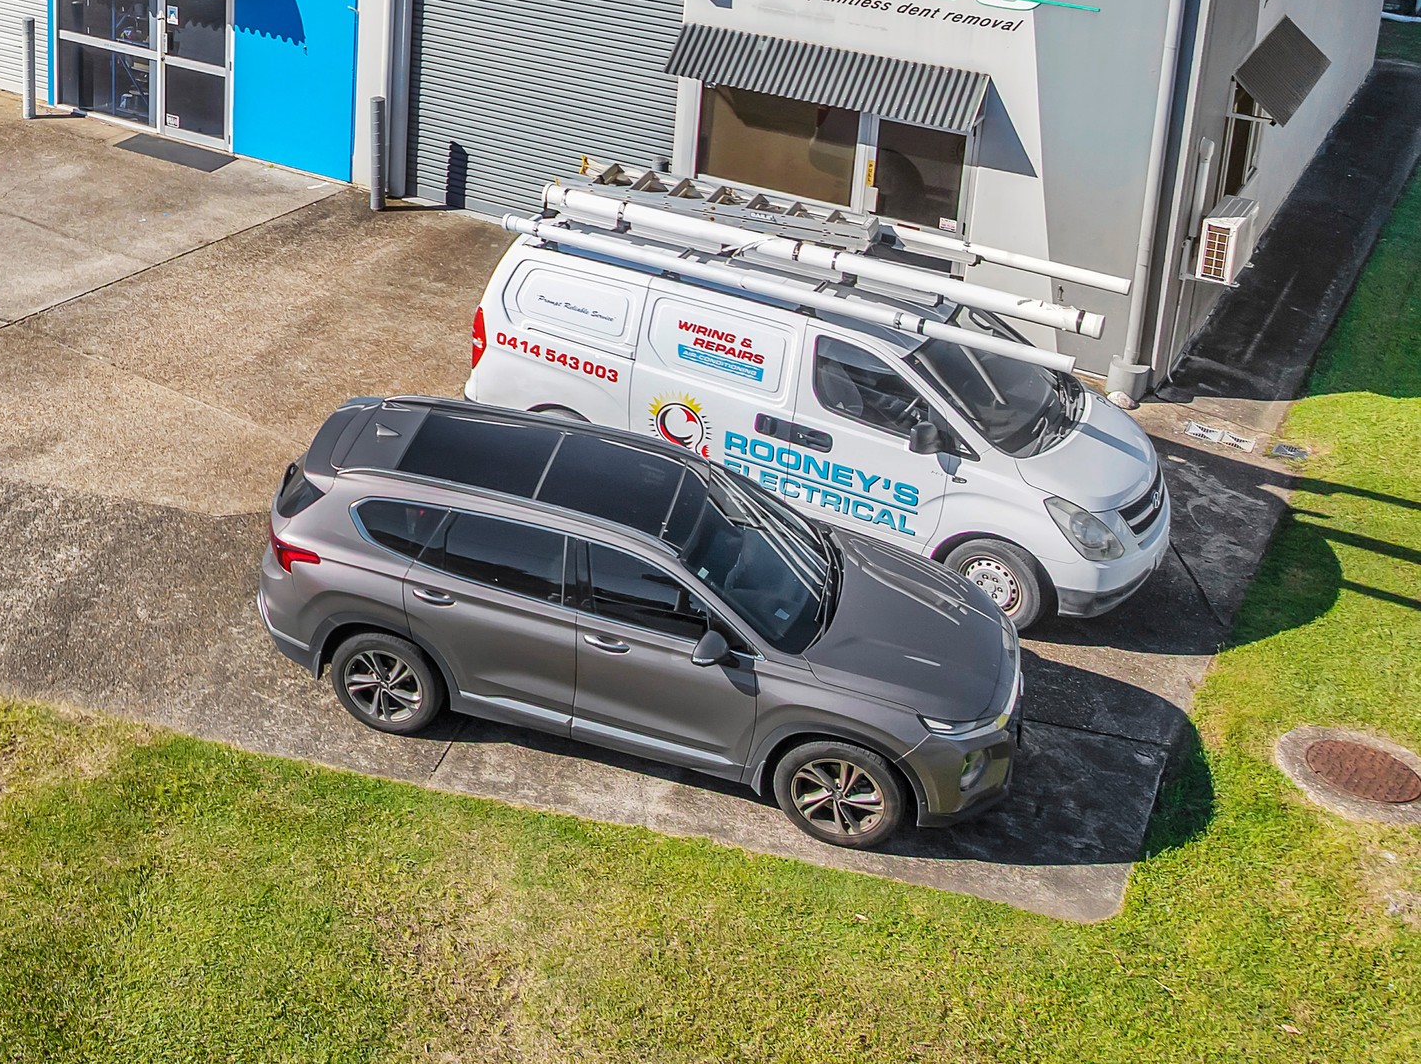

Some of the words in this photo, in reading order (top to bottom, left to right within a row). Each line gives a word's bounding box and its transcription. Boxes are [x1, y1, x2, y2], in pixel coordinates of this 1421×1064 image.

[896, 1, 941, 20] dent
[943, 10, 1024, 33] removal
[564, 302, 589, 315] Reliable
[678, 319, 736, 344] WIRING
[740, 337, 753, 349] &
[496, 332, 541, 358] 0414
[545, 349, 580, 371] 543
[582, 361, 619, 384] 003
[681, 349, 758, 378] AIR-CONDITIONING
[693, 337, 765, 365] REPAIRS
[724, 430, 920, 507] ROONEY'S
